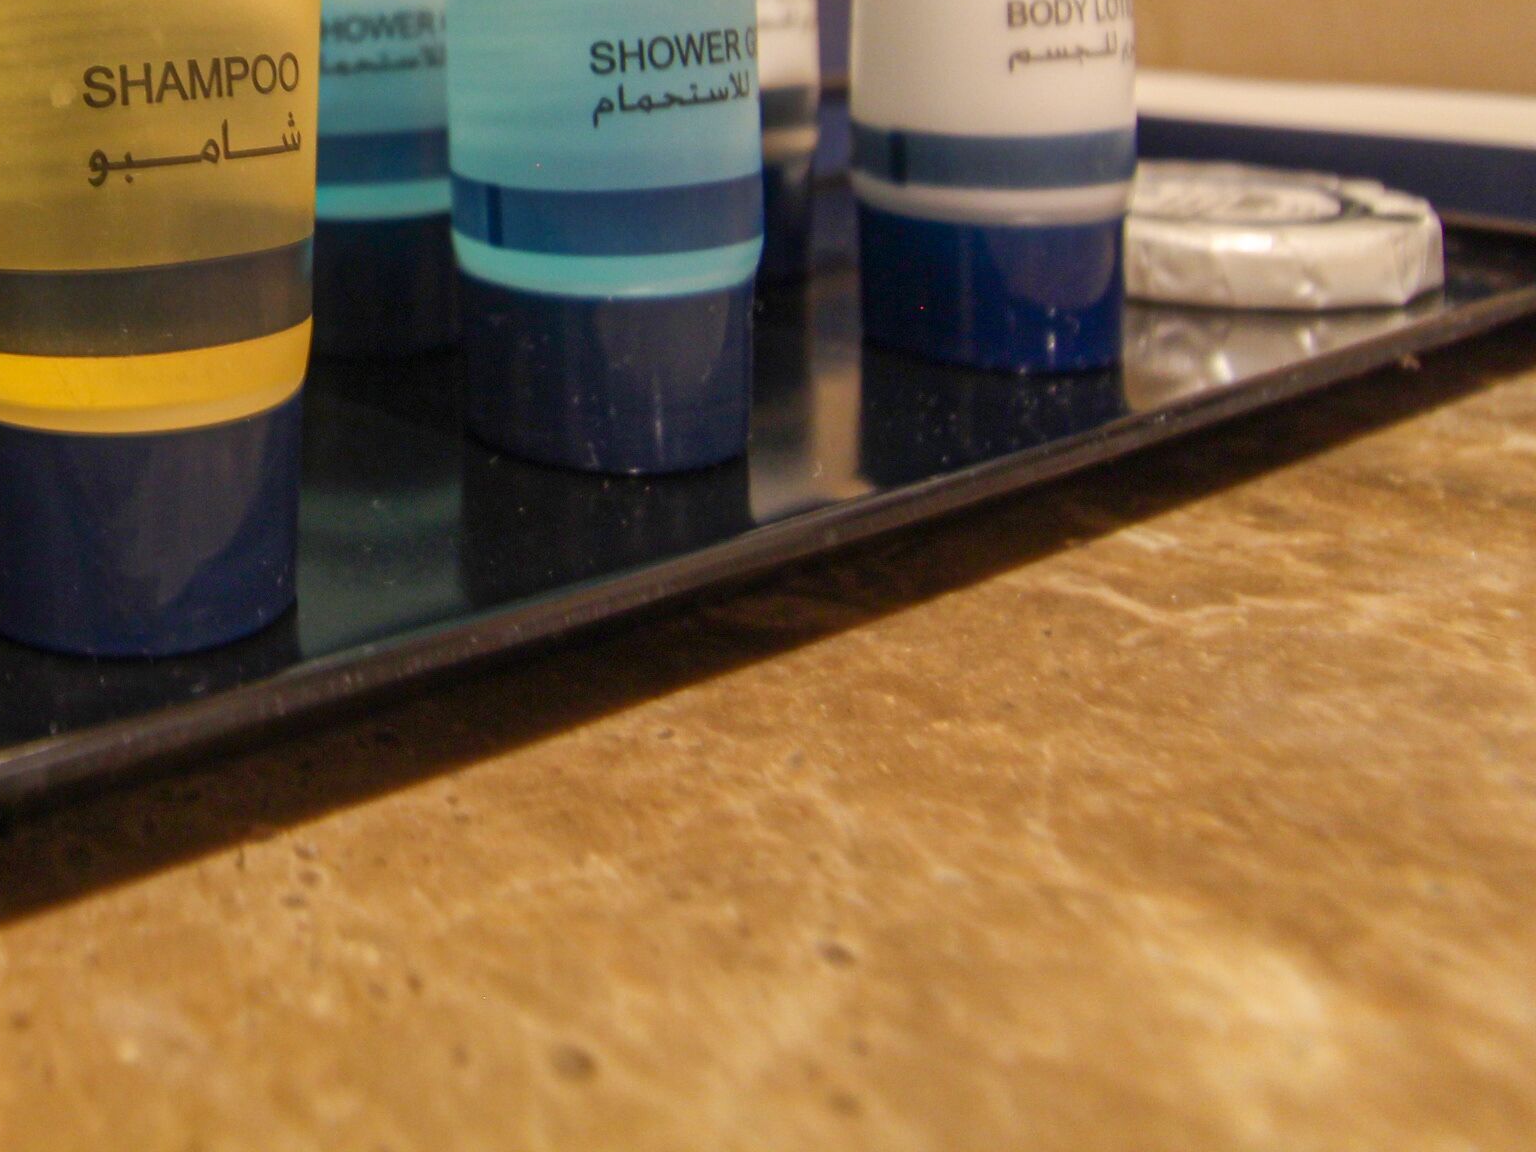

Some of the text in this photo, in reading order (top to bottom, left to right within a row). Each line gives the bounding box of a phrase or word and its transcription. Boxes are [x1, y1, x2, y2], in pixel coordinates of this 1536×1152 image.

[320, 9, 434, 43] HOWER
[590, 27, 741, 75] SHOWER
[82, 51, 300, 109] SHAMPOO
[87, 111, 302, 187] شامبو
